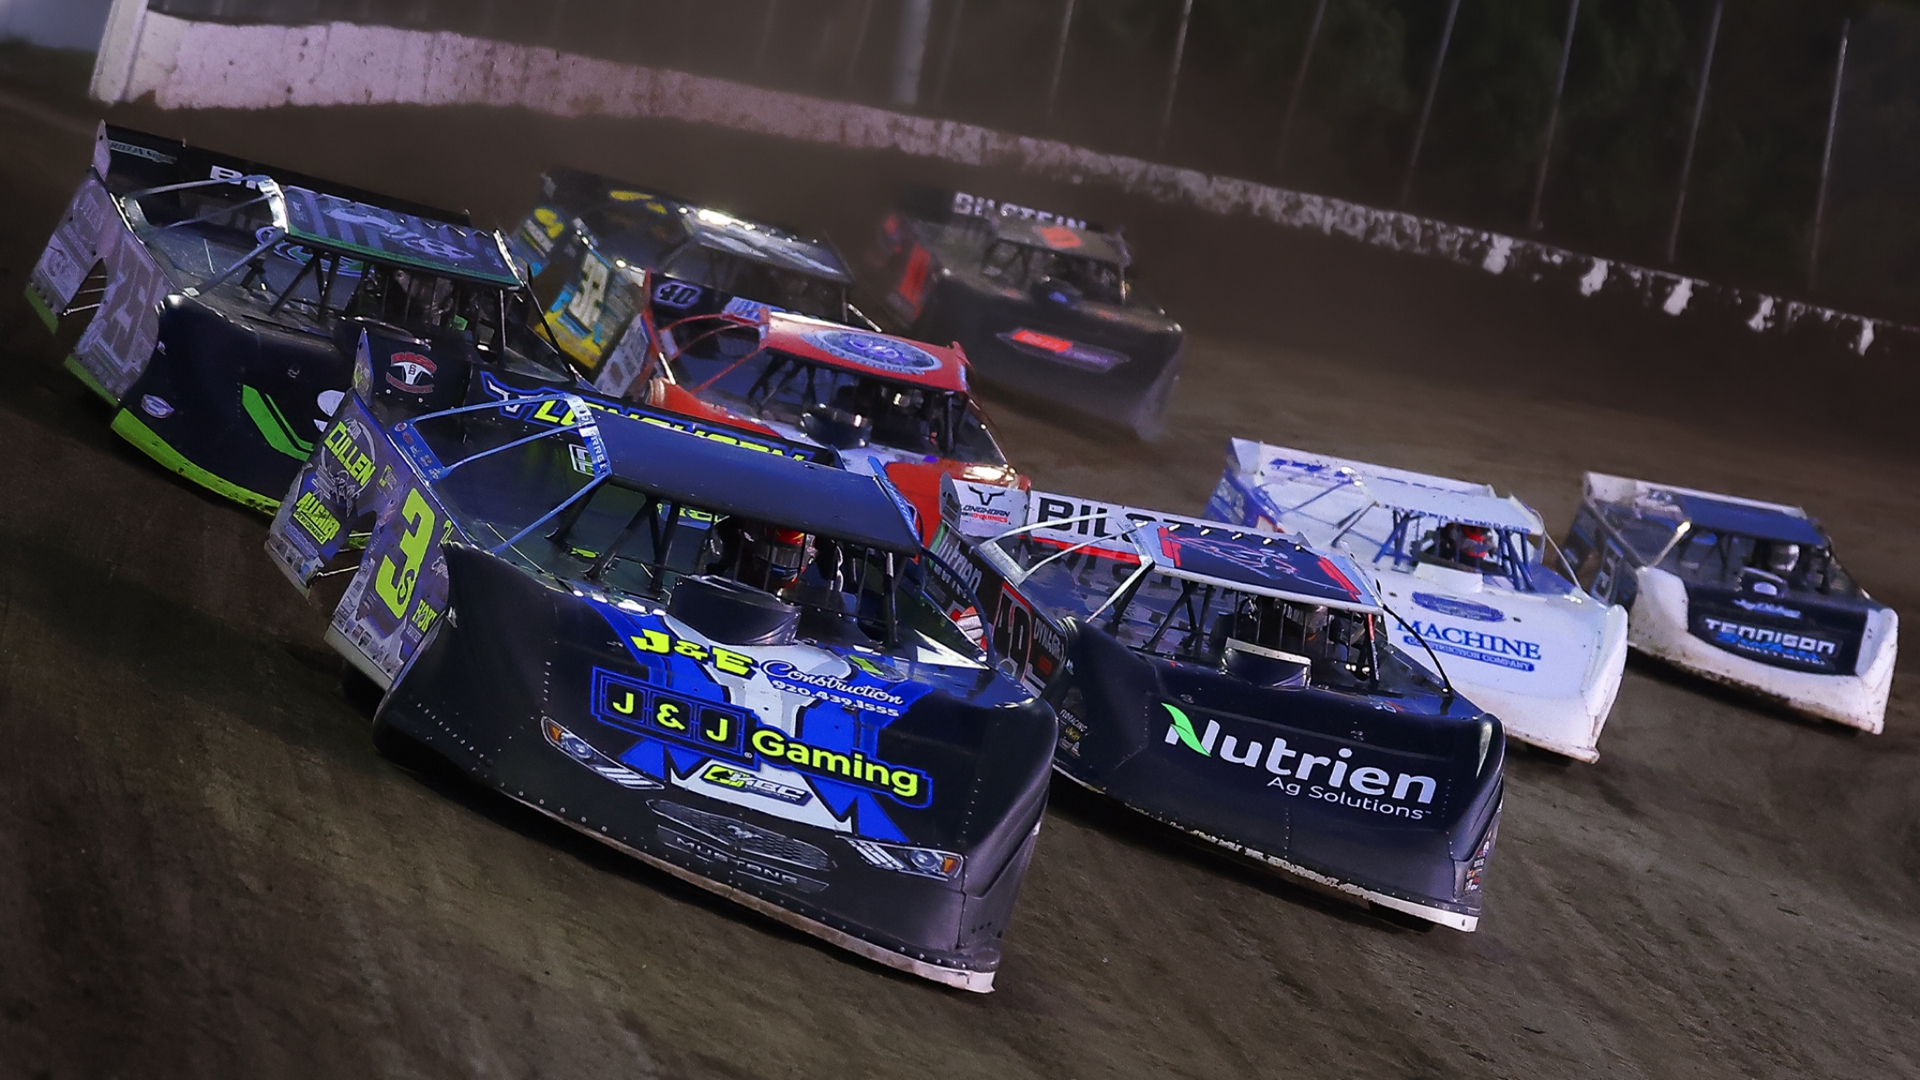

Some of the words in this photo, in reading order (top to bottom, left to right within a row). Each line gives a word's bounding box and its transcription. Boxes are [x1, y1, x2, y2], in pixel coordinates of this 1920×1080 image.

[324, 421, 376, 487] CULLEN
[1396, 618, 1541, 660] MACHINE
[761, 659, 904, 706] Construction
[1482, 654, 1530, 672] COMPANY
[612, 692, 635, 714] J
[705, 718, 729, 743] J
[751, 729, 919, 798] Gaming
[1161, 702, 1437, 804] Nutrien
[1266, 776, 1298, 798] Ag
[1308, 786, 1426, 821] Solutions
[676, 836, 798, 884] MUSTANG
